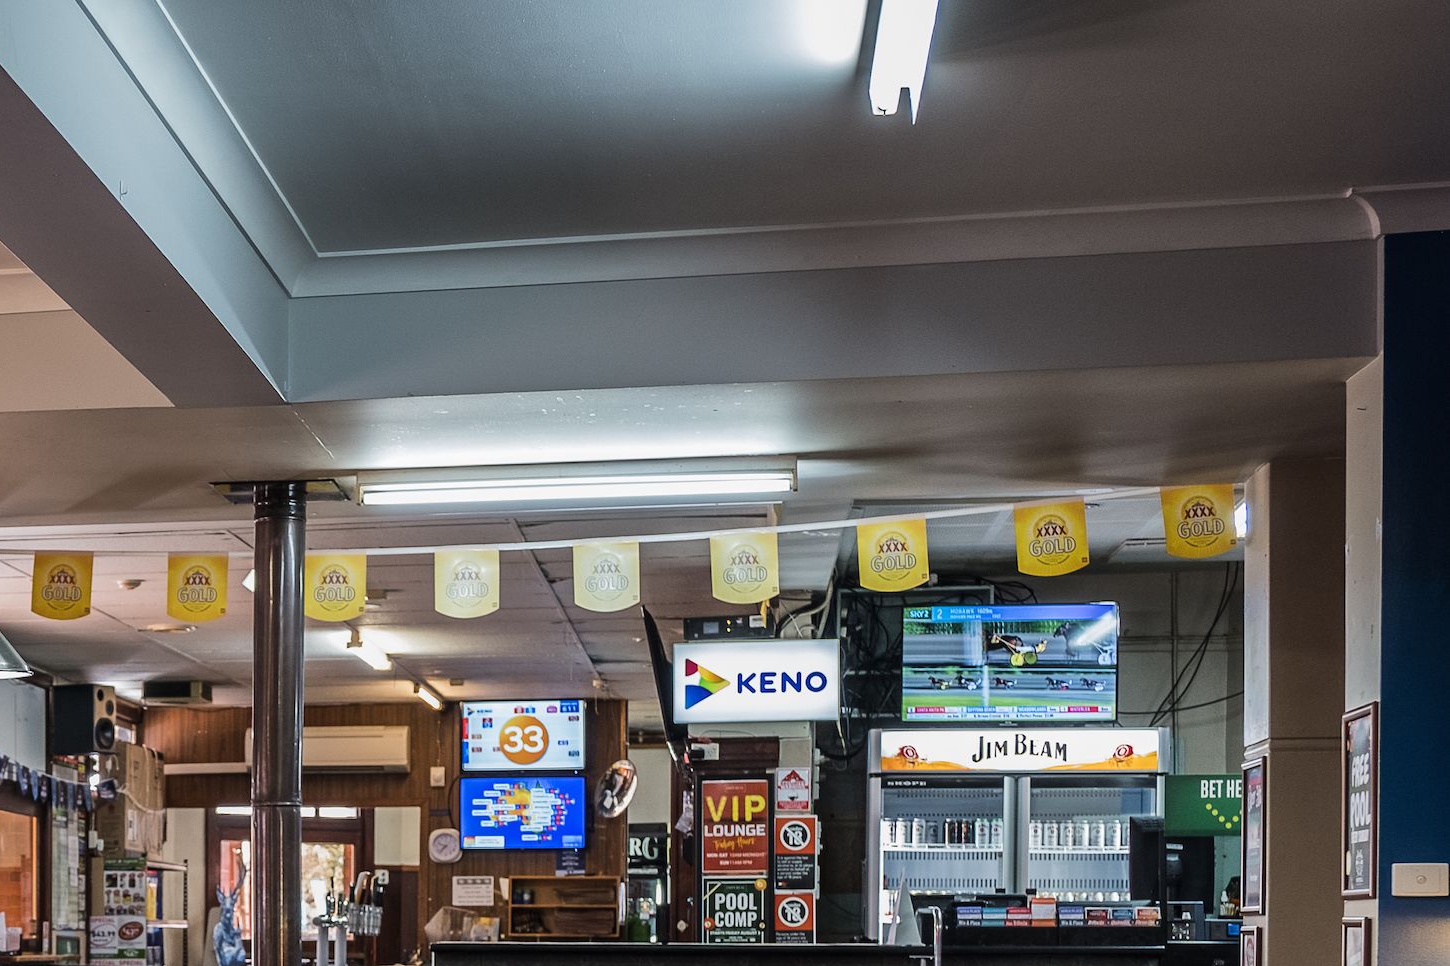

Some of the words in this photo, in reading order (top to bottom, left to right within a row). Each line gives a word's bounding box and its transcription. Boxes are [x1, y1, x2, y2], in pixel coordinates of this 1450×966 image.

[1184, 508, 1216, 519] XXXX
[1036, 526, 1067, 538] XXXX
[1177, 519, 1225, 538] GOLD
[878, 542, 908, 553] XXXX
[1028, 537, 1076, 557] GOLD
[730, 555, 759, 565] XXXX
[871, 554, 916, 572] GOLD
[453, 572, 480, 581] XXXX
[593, 564, 620, 574] XXXX
[723, 566, 767, 584] GOLD
[49, 575, 75, 585] XXXX
[184, 576, 211, 585] XXXX
[321, 574, 348, 585] XXXX
[585, 576, 629, 592] GOLD
[41, 585, 81, 601] GOLD
[177, 587, 217, 603] GOLD
[314, 586, 355, 602] GOLD
[446, 582, 489, 598] GOLD
[937, 609, 943, 620] 2
[737, 671, 828, 694] KENO
[503, 725, 544, 753] 33
[972, 735, 1008, 763] JIM
[1014, 733, 1067, 762] BEAM
[1352, 752, 1369, 787] FREE
[1200, 779, 1223, 798] BET
[705, 794, 766, 822] VIP
[1351, 790, 1371, 828] POOL
[704, 824, 766, 837] LOUNGE
[715, 892, 758, 910] POOL
[715, 912, 758, 928] COMP
